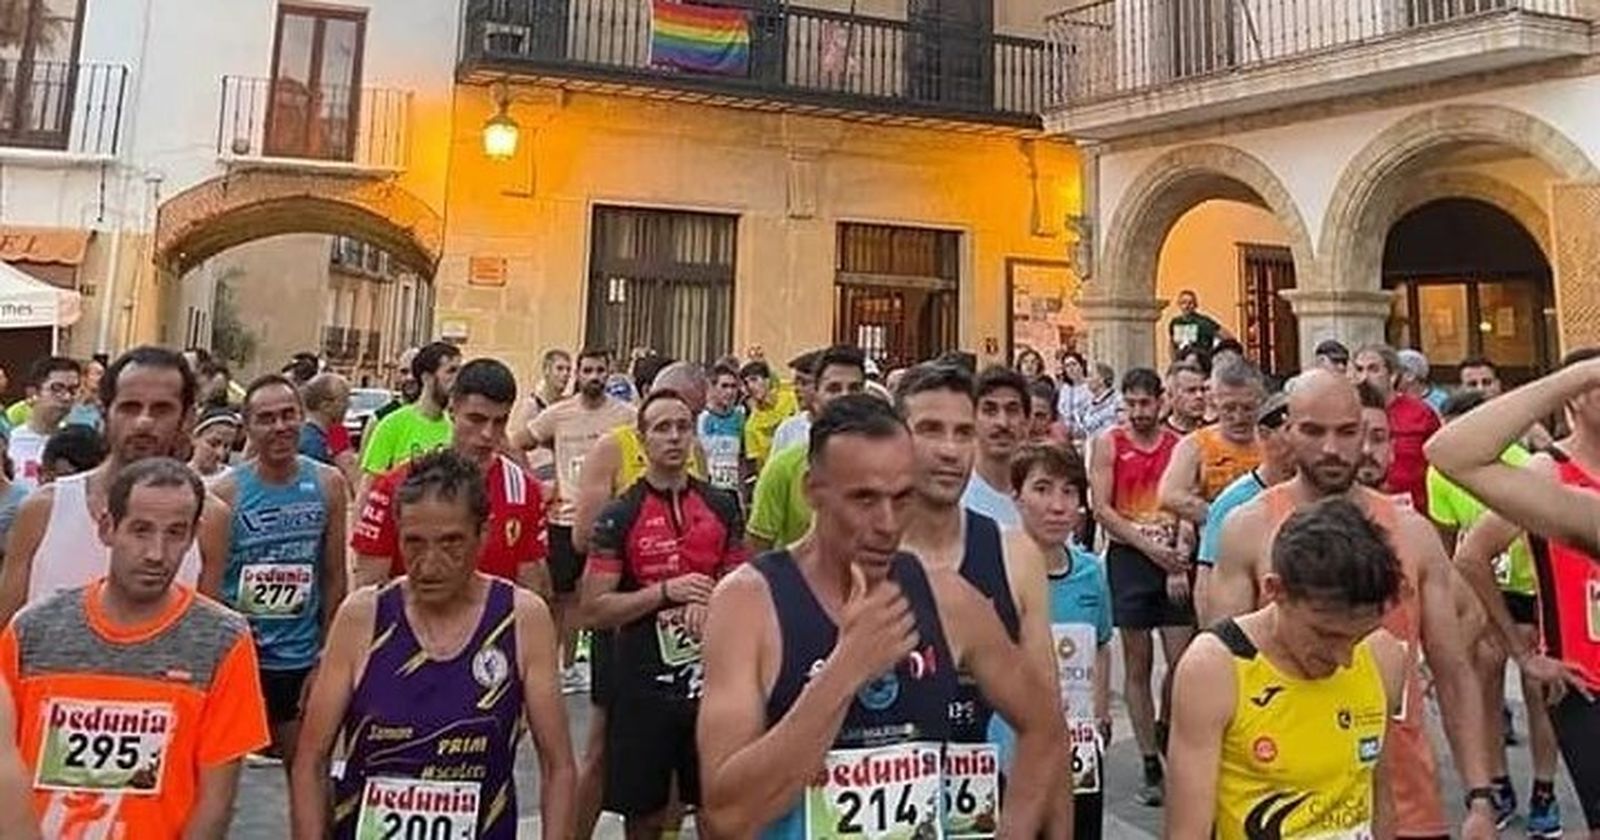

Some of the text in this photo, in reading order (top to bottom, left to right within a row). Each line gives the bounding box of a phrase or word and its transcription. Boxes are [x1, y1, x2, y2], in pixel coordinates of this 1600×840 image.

[253, 583, 297, 606] 277
[50, 703, 168, 735] bedunia
[65, 732, 141, 770] 295
[367, 782, 476, 813] bedunia
[836, 783, 918, 835] 214
[380, 812, 453, 840] 200
